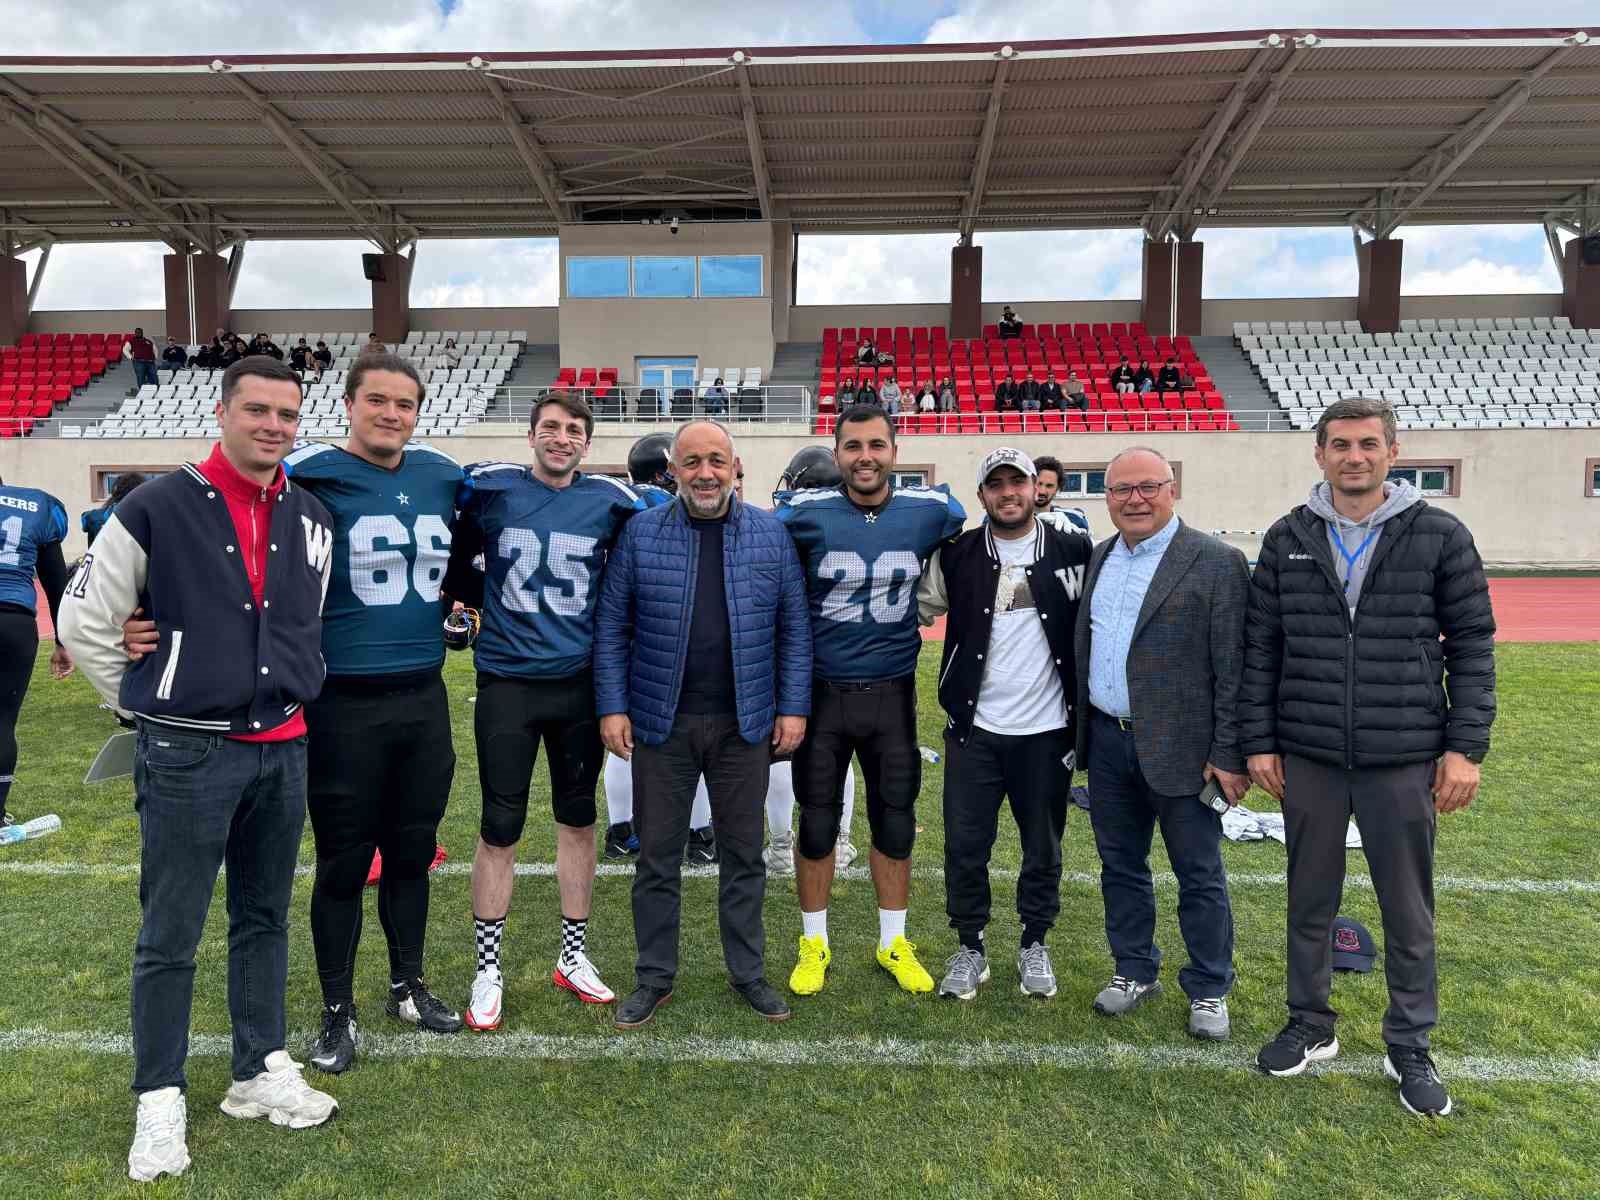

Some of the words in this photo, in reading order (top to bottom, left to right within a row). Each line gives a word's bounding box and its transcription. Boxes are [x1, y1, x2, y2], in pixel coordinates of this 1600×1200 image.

[301, 515, 333, 573] W
[349, 515, 452, 606] 66
[498, 527, 598, 616] 25
[818, 551, 921, 623] 20
[1054, 564, 1085, 602] W
